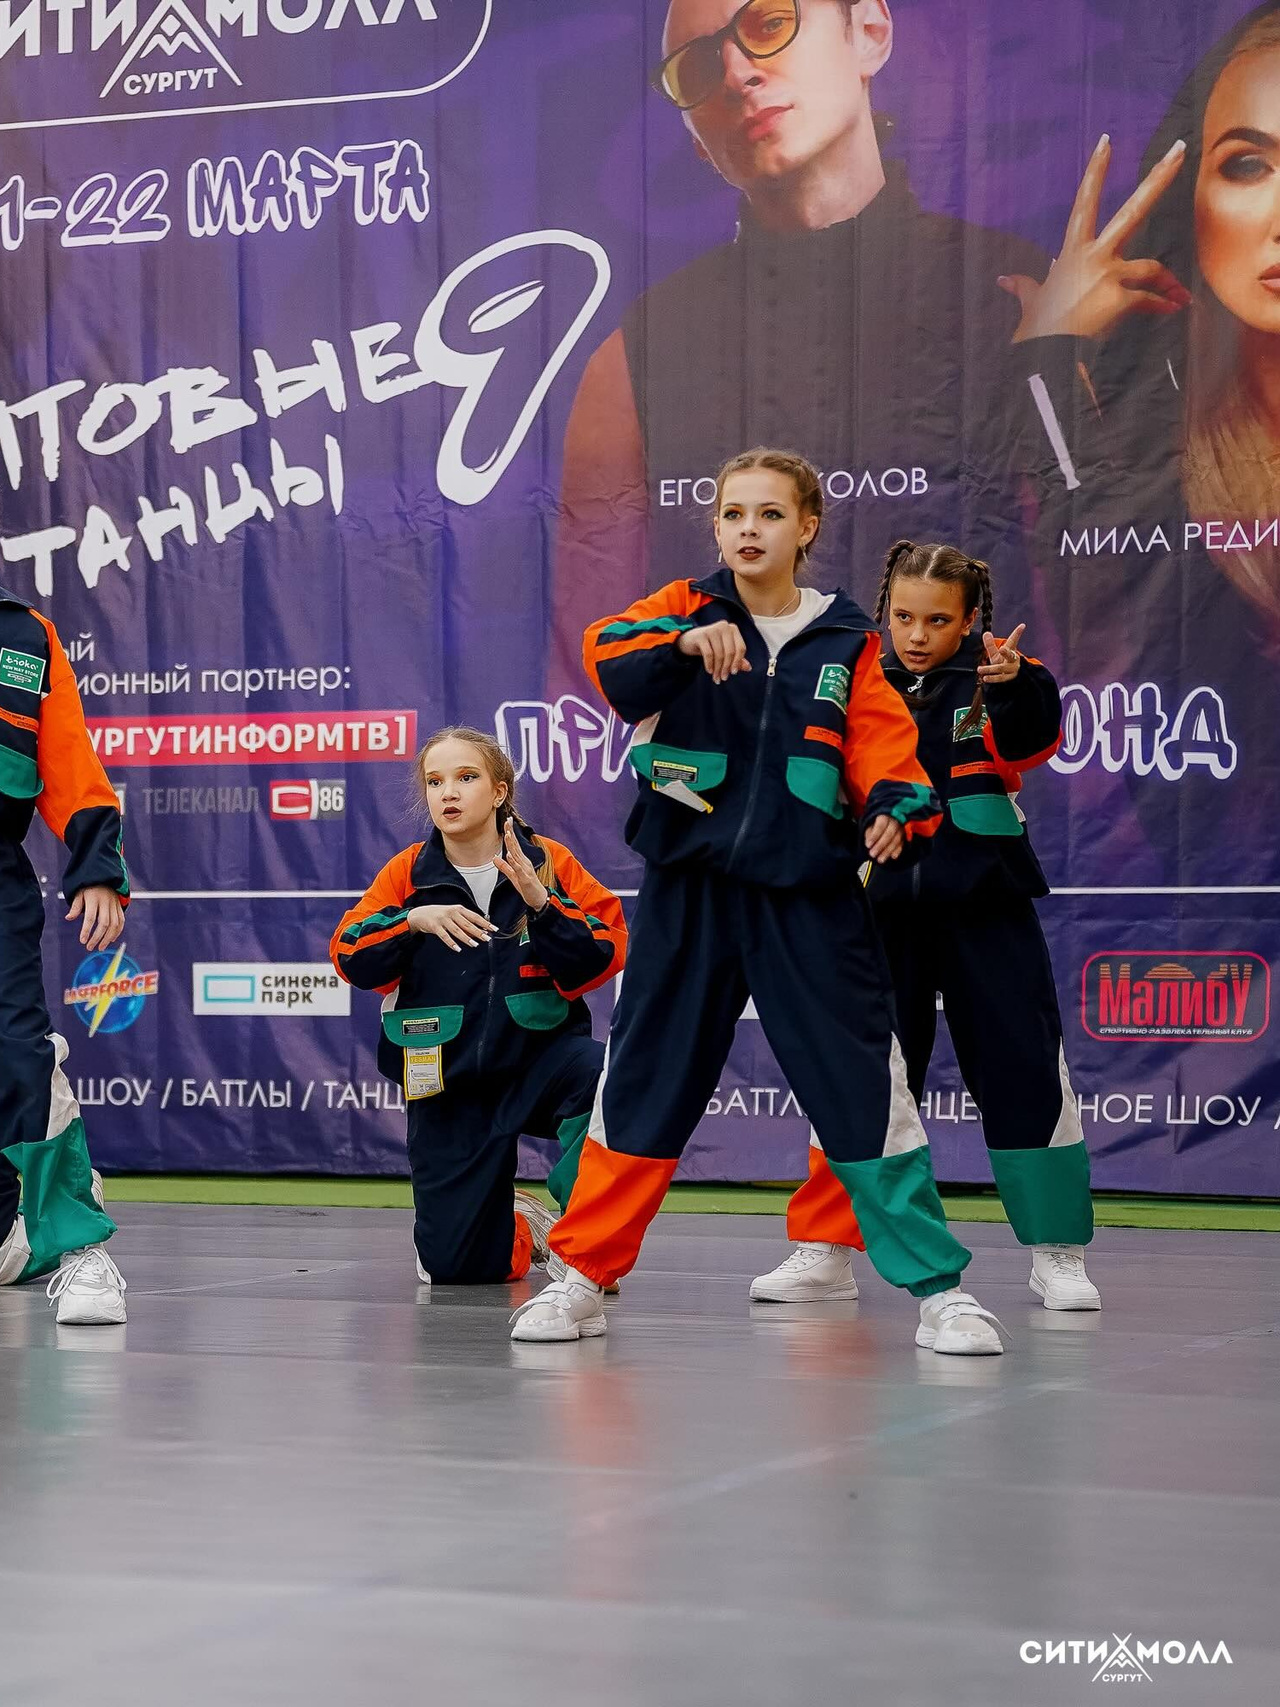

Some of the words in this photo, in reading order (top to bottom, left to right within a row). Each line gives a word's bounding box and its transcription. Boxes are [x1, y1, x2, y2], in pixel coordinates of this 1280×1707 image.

[123, 67, 218, 95] СУРГУТ
[186, 139, 429, 238] МАРТА
[659, 476, 719, 506] ЕГО
[0, 433, 345, 598] ТАНЦЫ
[1060, 524, 1171, 557] МИЛА
[142, 786, 260, 815] ТЕЛЕКАНАЛ
[261, 975, 339, 988] синема
[261, 990, 313, 1009] парк
[77, 1077, 152, 1107] ШОУ
[181, 1078, 292, 1108] БАТТЛЫ
[323, 1079, 406, 1114] ТАНЦ
[705, 1086, 805, 1117] БАТТЛ
[1166, 1094, 1262, 1127] ШОУ
